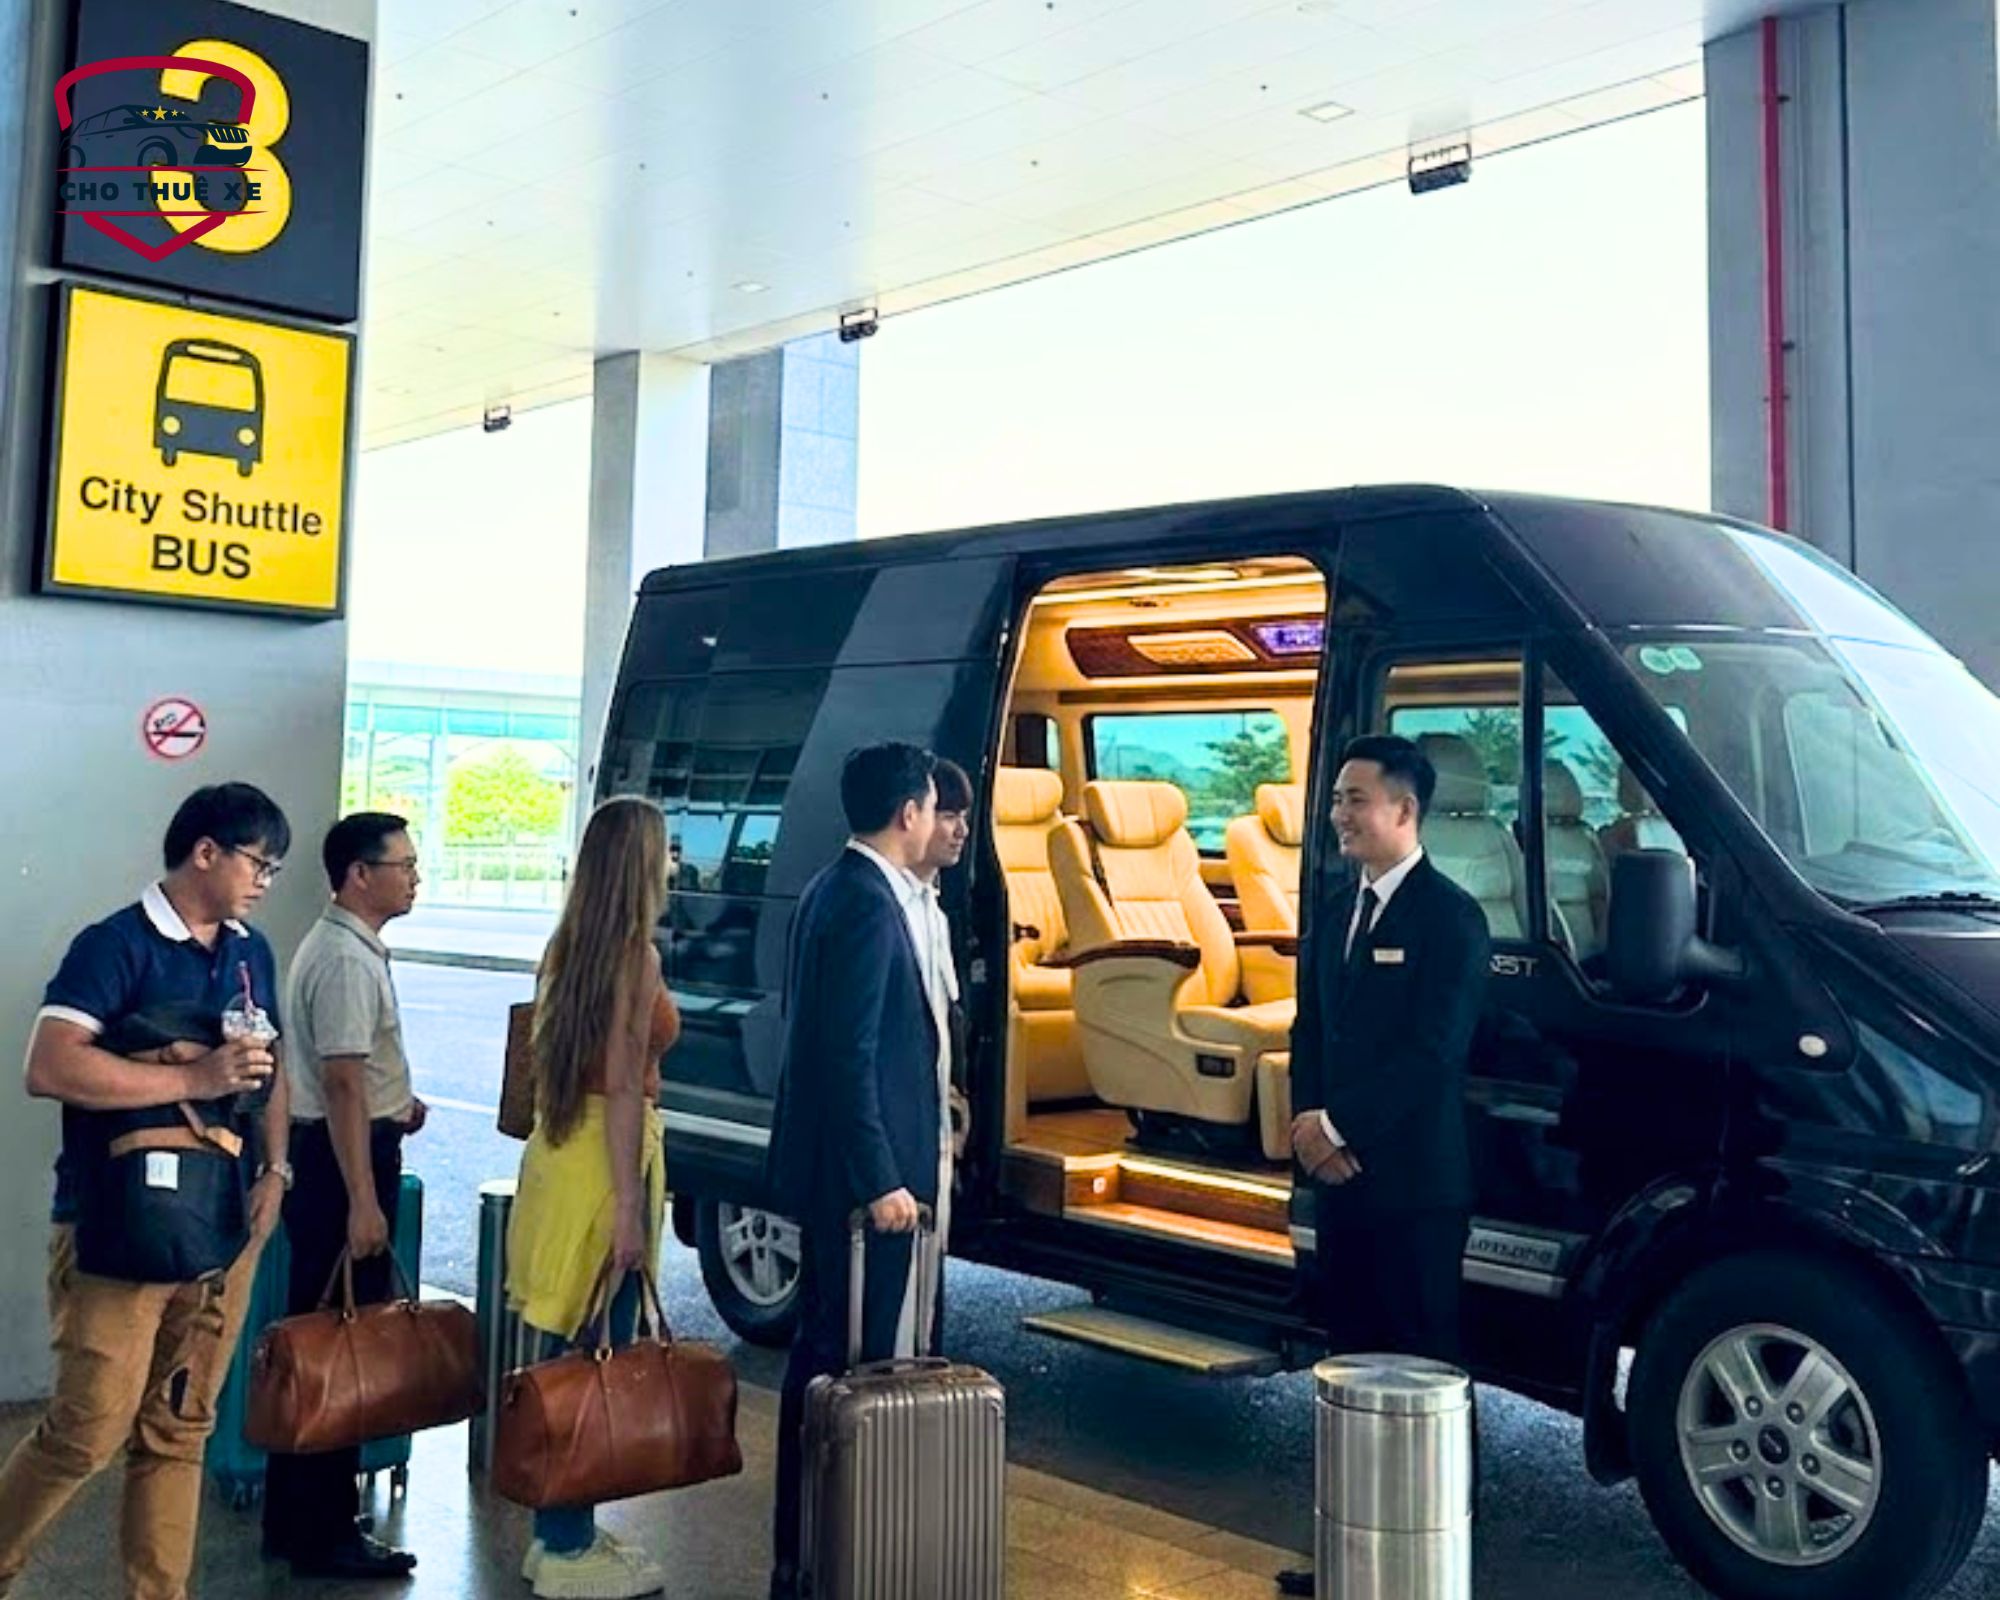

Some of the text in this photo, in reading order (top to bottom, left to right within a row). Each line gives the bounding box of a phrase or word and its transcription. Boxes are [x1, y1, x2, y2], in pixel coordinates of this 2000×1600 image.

[152, 38, 292, 255] 3
[80, 476, 322, 536] City Shuttle
[151, 534, 251, 579] BUS
